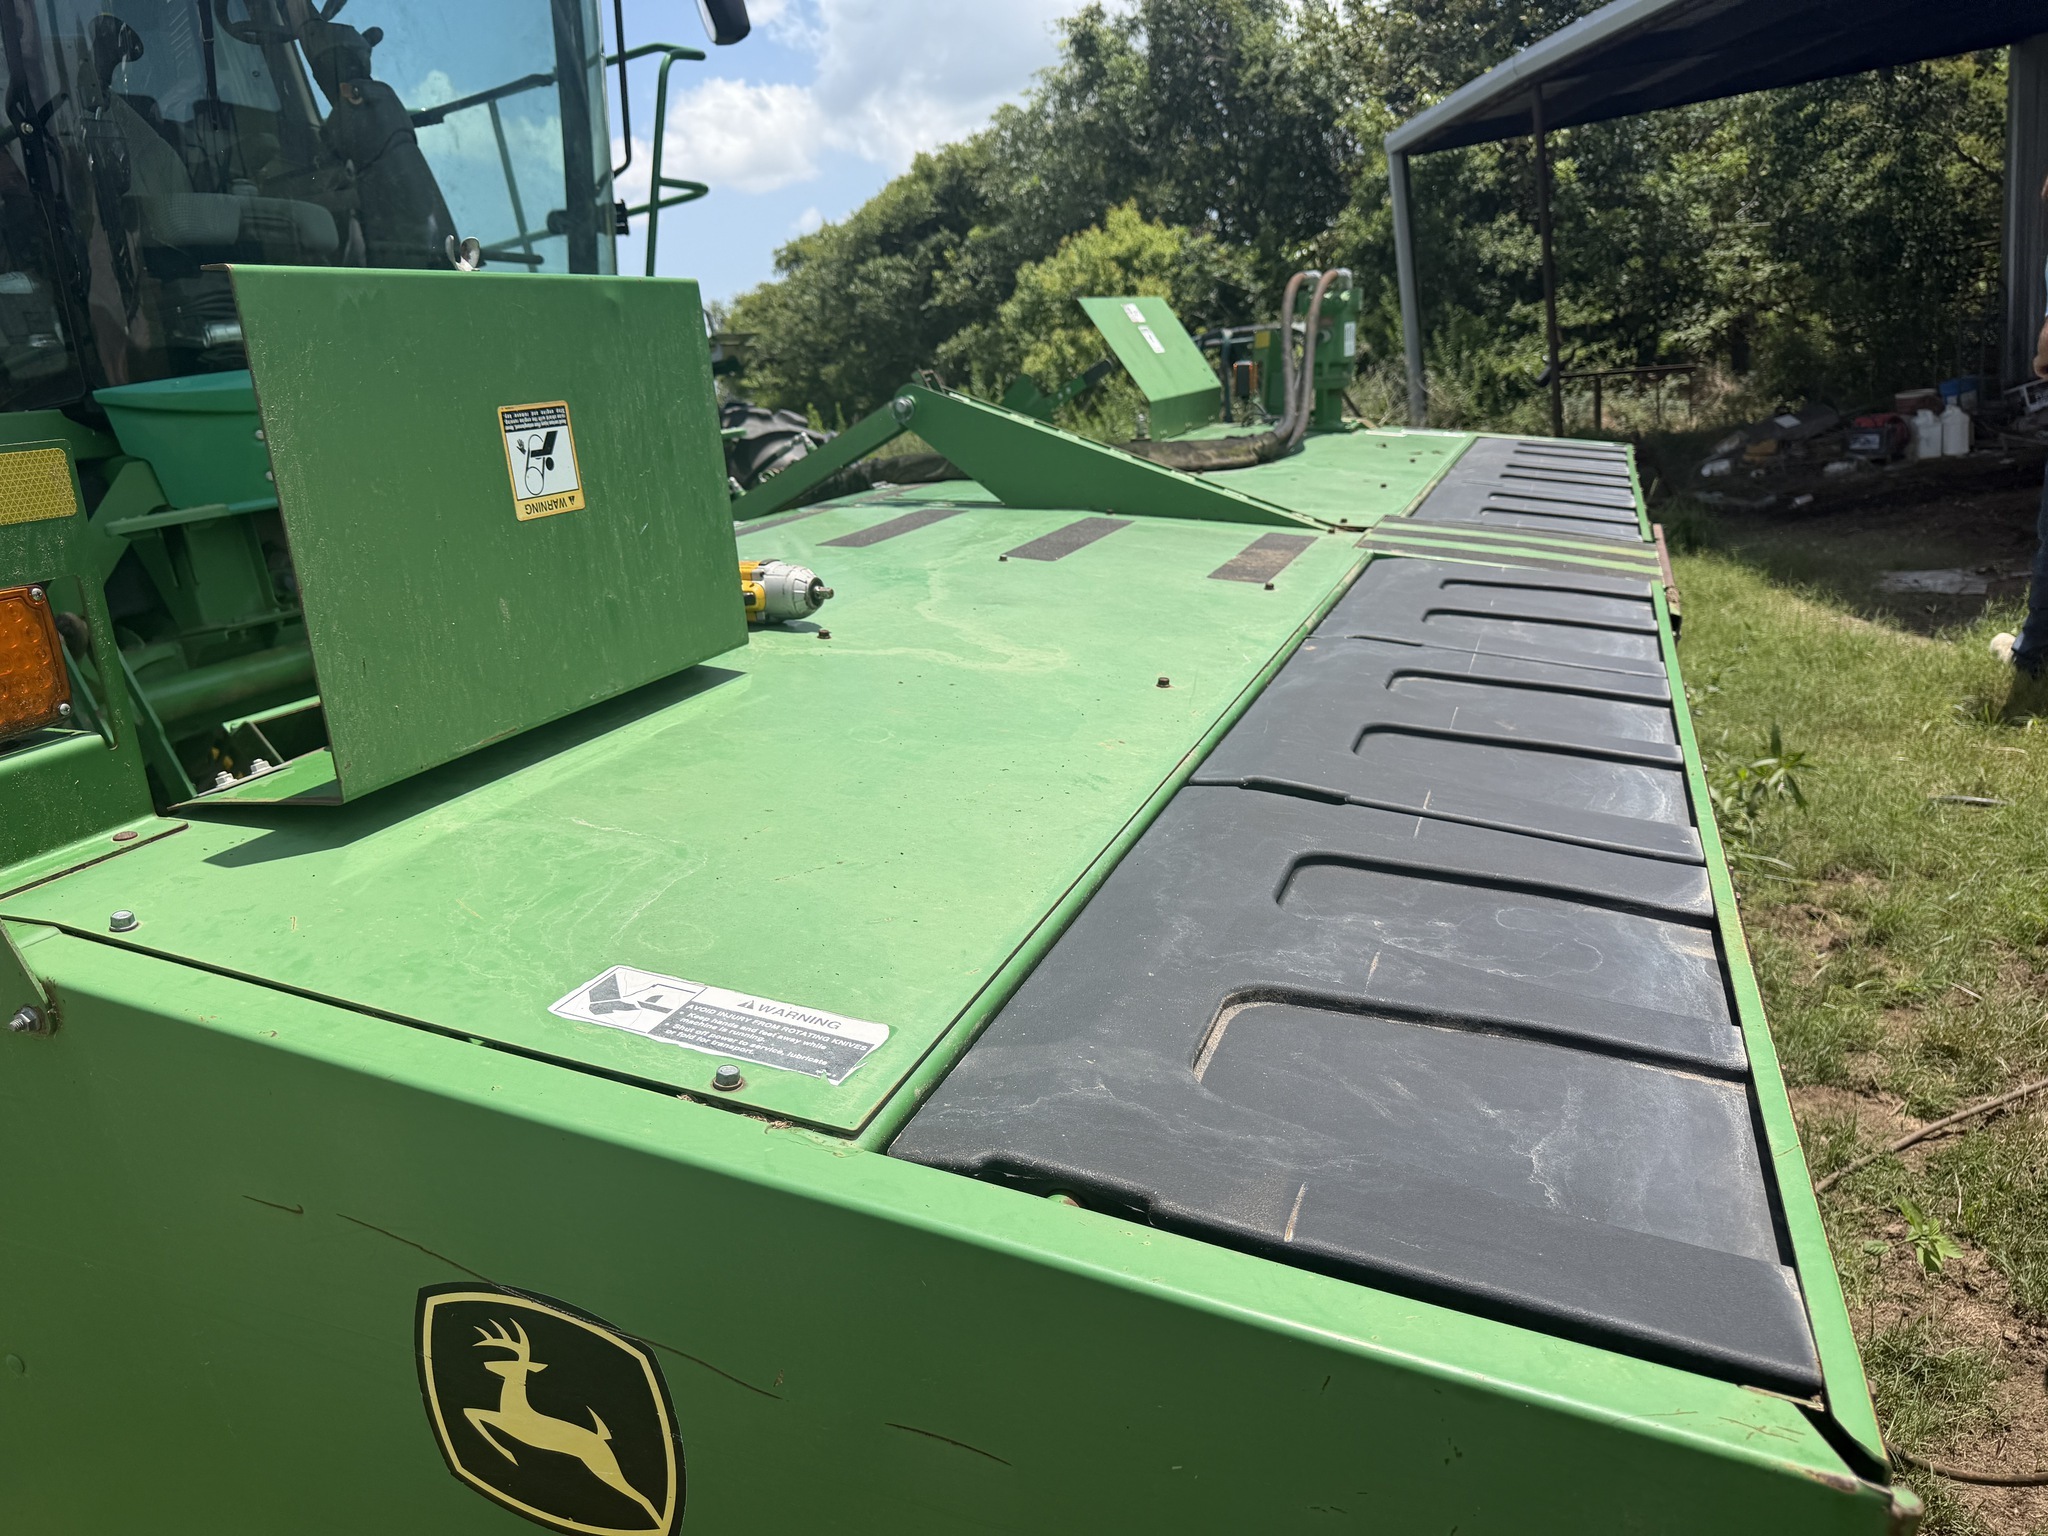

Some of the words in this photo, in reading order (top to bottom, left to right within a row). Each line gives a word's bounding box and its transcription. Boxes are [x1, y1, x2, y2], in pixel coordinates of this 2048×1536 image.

[524, 496, 568, 515] WARNING
[679, 1017, 718, 1030] machine
[718, 1024, 728, 1032] is
[728, 1029, 765, 1042] running.
[685, 1004, 717, 1015] AVOID
[716, 1010, 753, 1022] INJURY
[751, 1019, 782, 1031] FROM
[781, 1026, 830, 1043] ROTATING
[830, 1038, 869, 1051] KNIVES
[758, 1003, 842, 1030] WARNING
[672, 1023, 695, 1033] Shut
[694, 1028, 711, 1037] off
[710, 1033, 738, 1044] power
[749, 1043, 785, 1056] service,
[786, 1051, 828, 1066] lubricate
[686, 1012, 711, 1023] Keep
[710, 1017, 739, 1029] hands
[739, 1023, 758, 1034] and
[758, 1029, 778, 1038] feet
[776, 1033, 802, 1044] away
[802, 1040, 828, 1050] while
[696, 1036, 711, 1044] for
[710, 1040, 755, 1055] transport.
